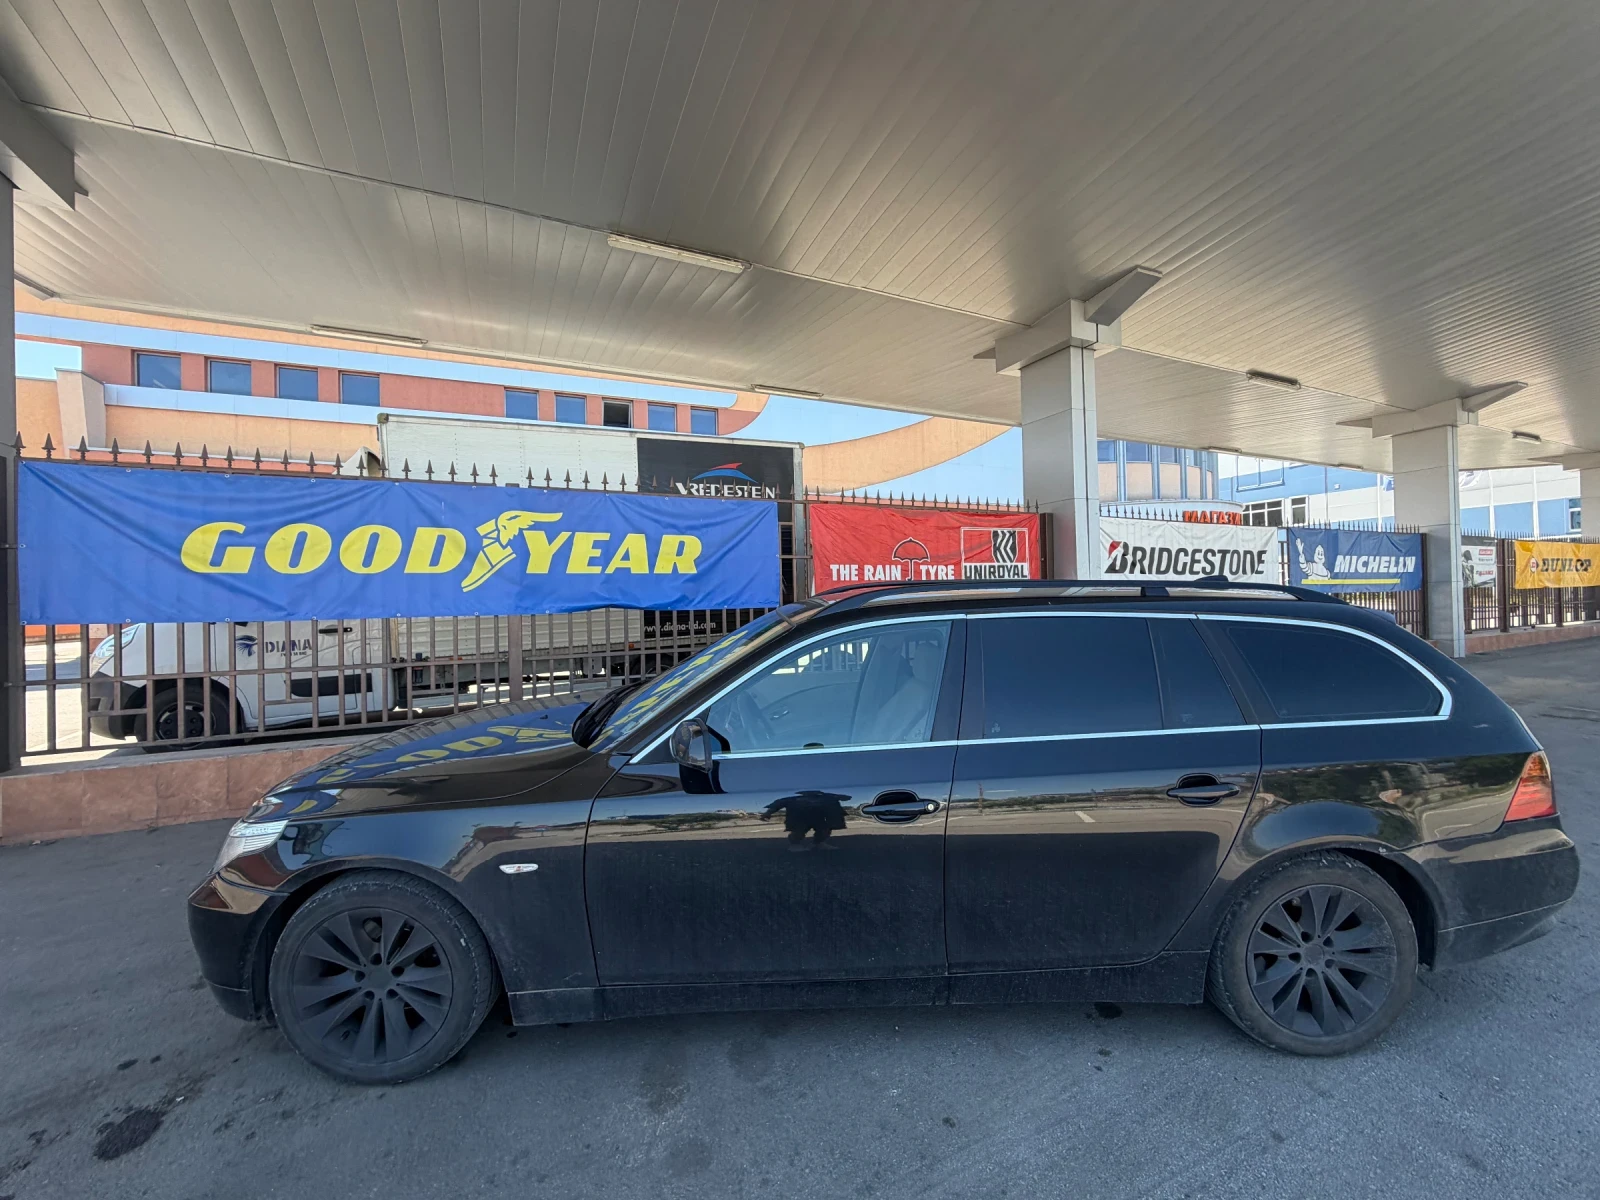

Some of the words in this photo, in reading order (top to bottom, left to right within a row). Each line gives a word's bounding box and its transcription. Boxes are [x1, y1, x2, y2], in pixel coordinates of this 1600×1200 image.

[675, 482, 776, 499] VREDESTEN
[1104, 540, 1268, 576] BRIDGESTONE
[1333, 554, 1416, 573] MICHELIN
[1541, 557, 1592, 573] DUNLOP
[830, 564, 858, 581] THE
[864, 564, 901, 581] RAIN
[919, 564, 955, 581] TYRE
[963, 564, 1028, 579] UNIROYAL
